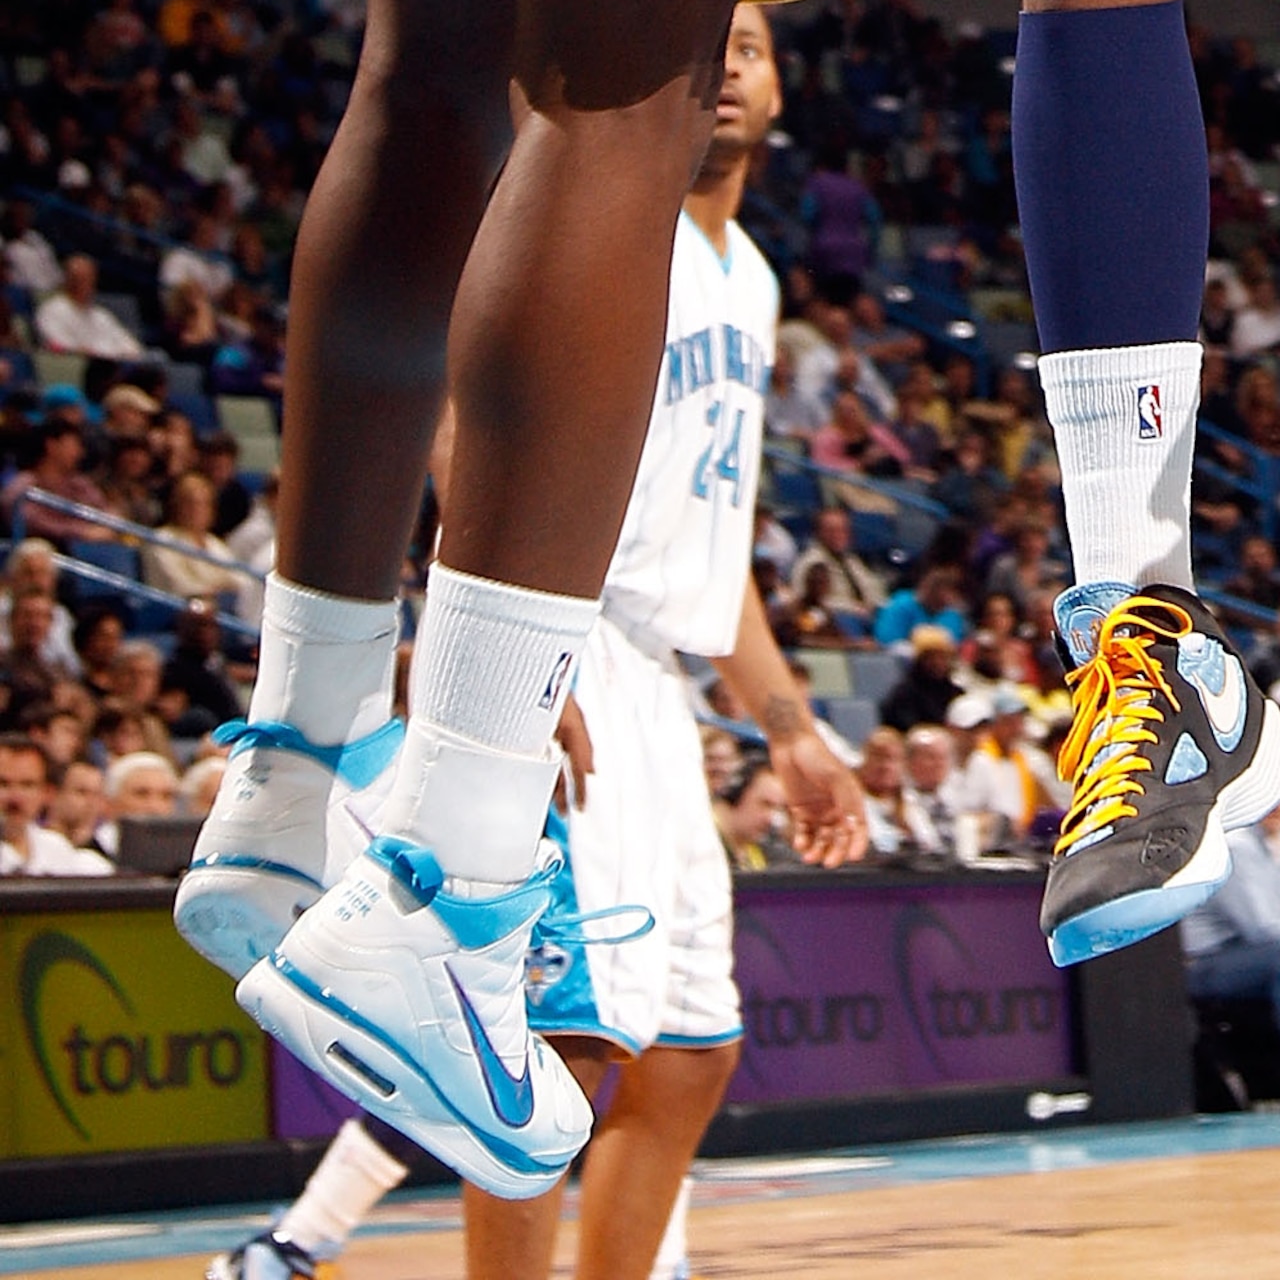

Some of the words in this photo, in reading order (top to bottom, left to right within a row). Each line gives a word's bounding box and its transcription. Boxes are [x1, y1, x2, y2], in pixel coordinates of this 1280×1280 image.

[692, 400, 744, 508] 24
[746, 986, 884, 1048] touro
[930, 981, 1053, 1038] touro
[64, 1024, 243, 1095] touro
